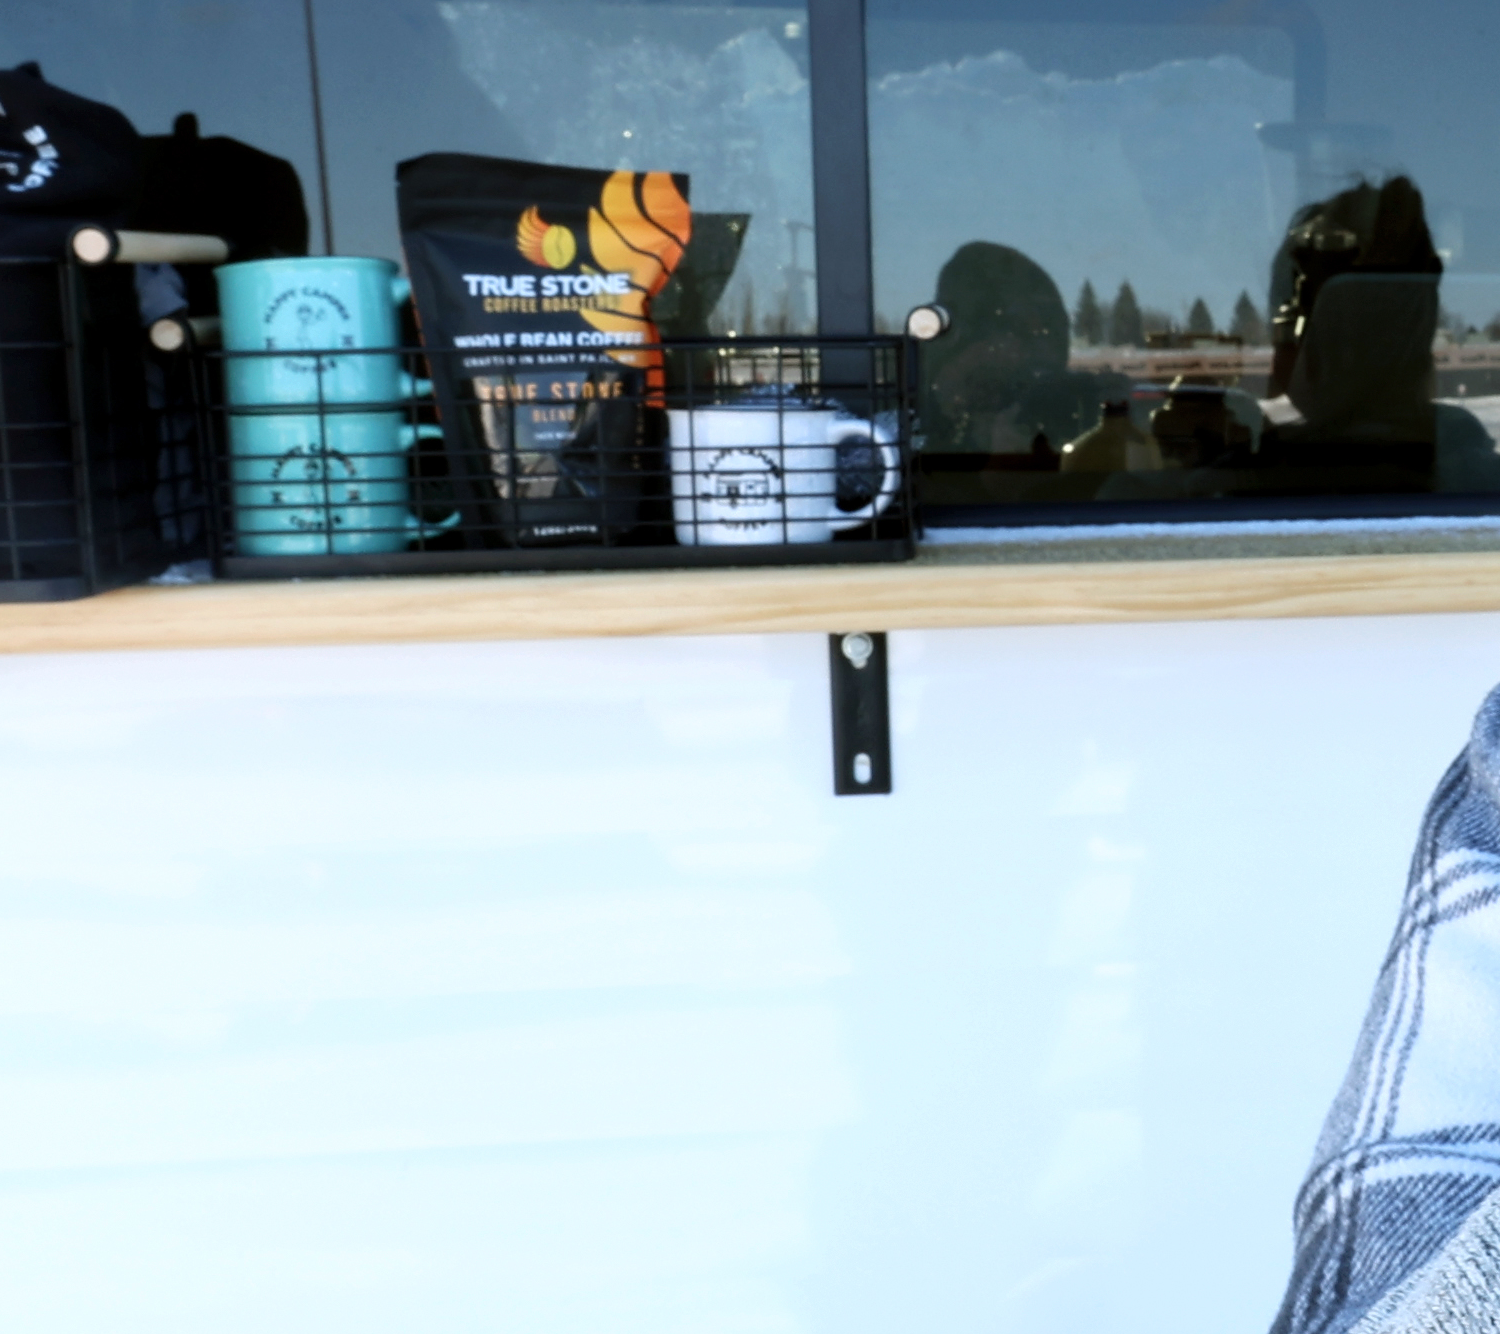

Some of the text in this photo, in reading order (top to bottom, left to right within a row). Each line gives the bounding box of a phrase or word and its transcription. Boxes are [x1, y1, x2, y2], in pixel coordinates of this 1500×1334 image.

[462, 272, 632, 297] TRUE STONE
[483, 296, 538, 314] COFFEE
[453, 331, 645, 349] WHOLE BEAN COFFEE
